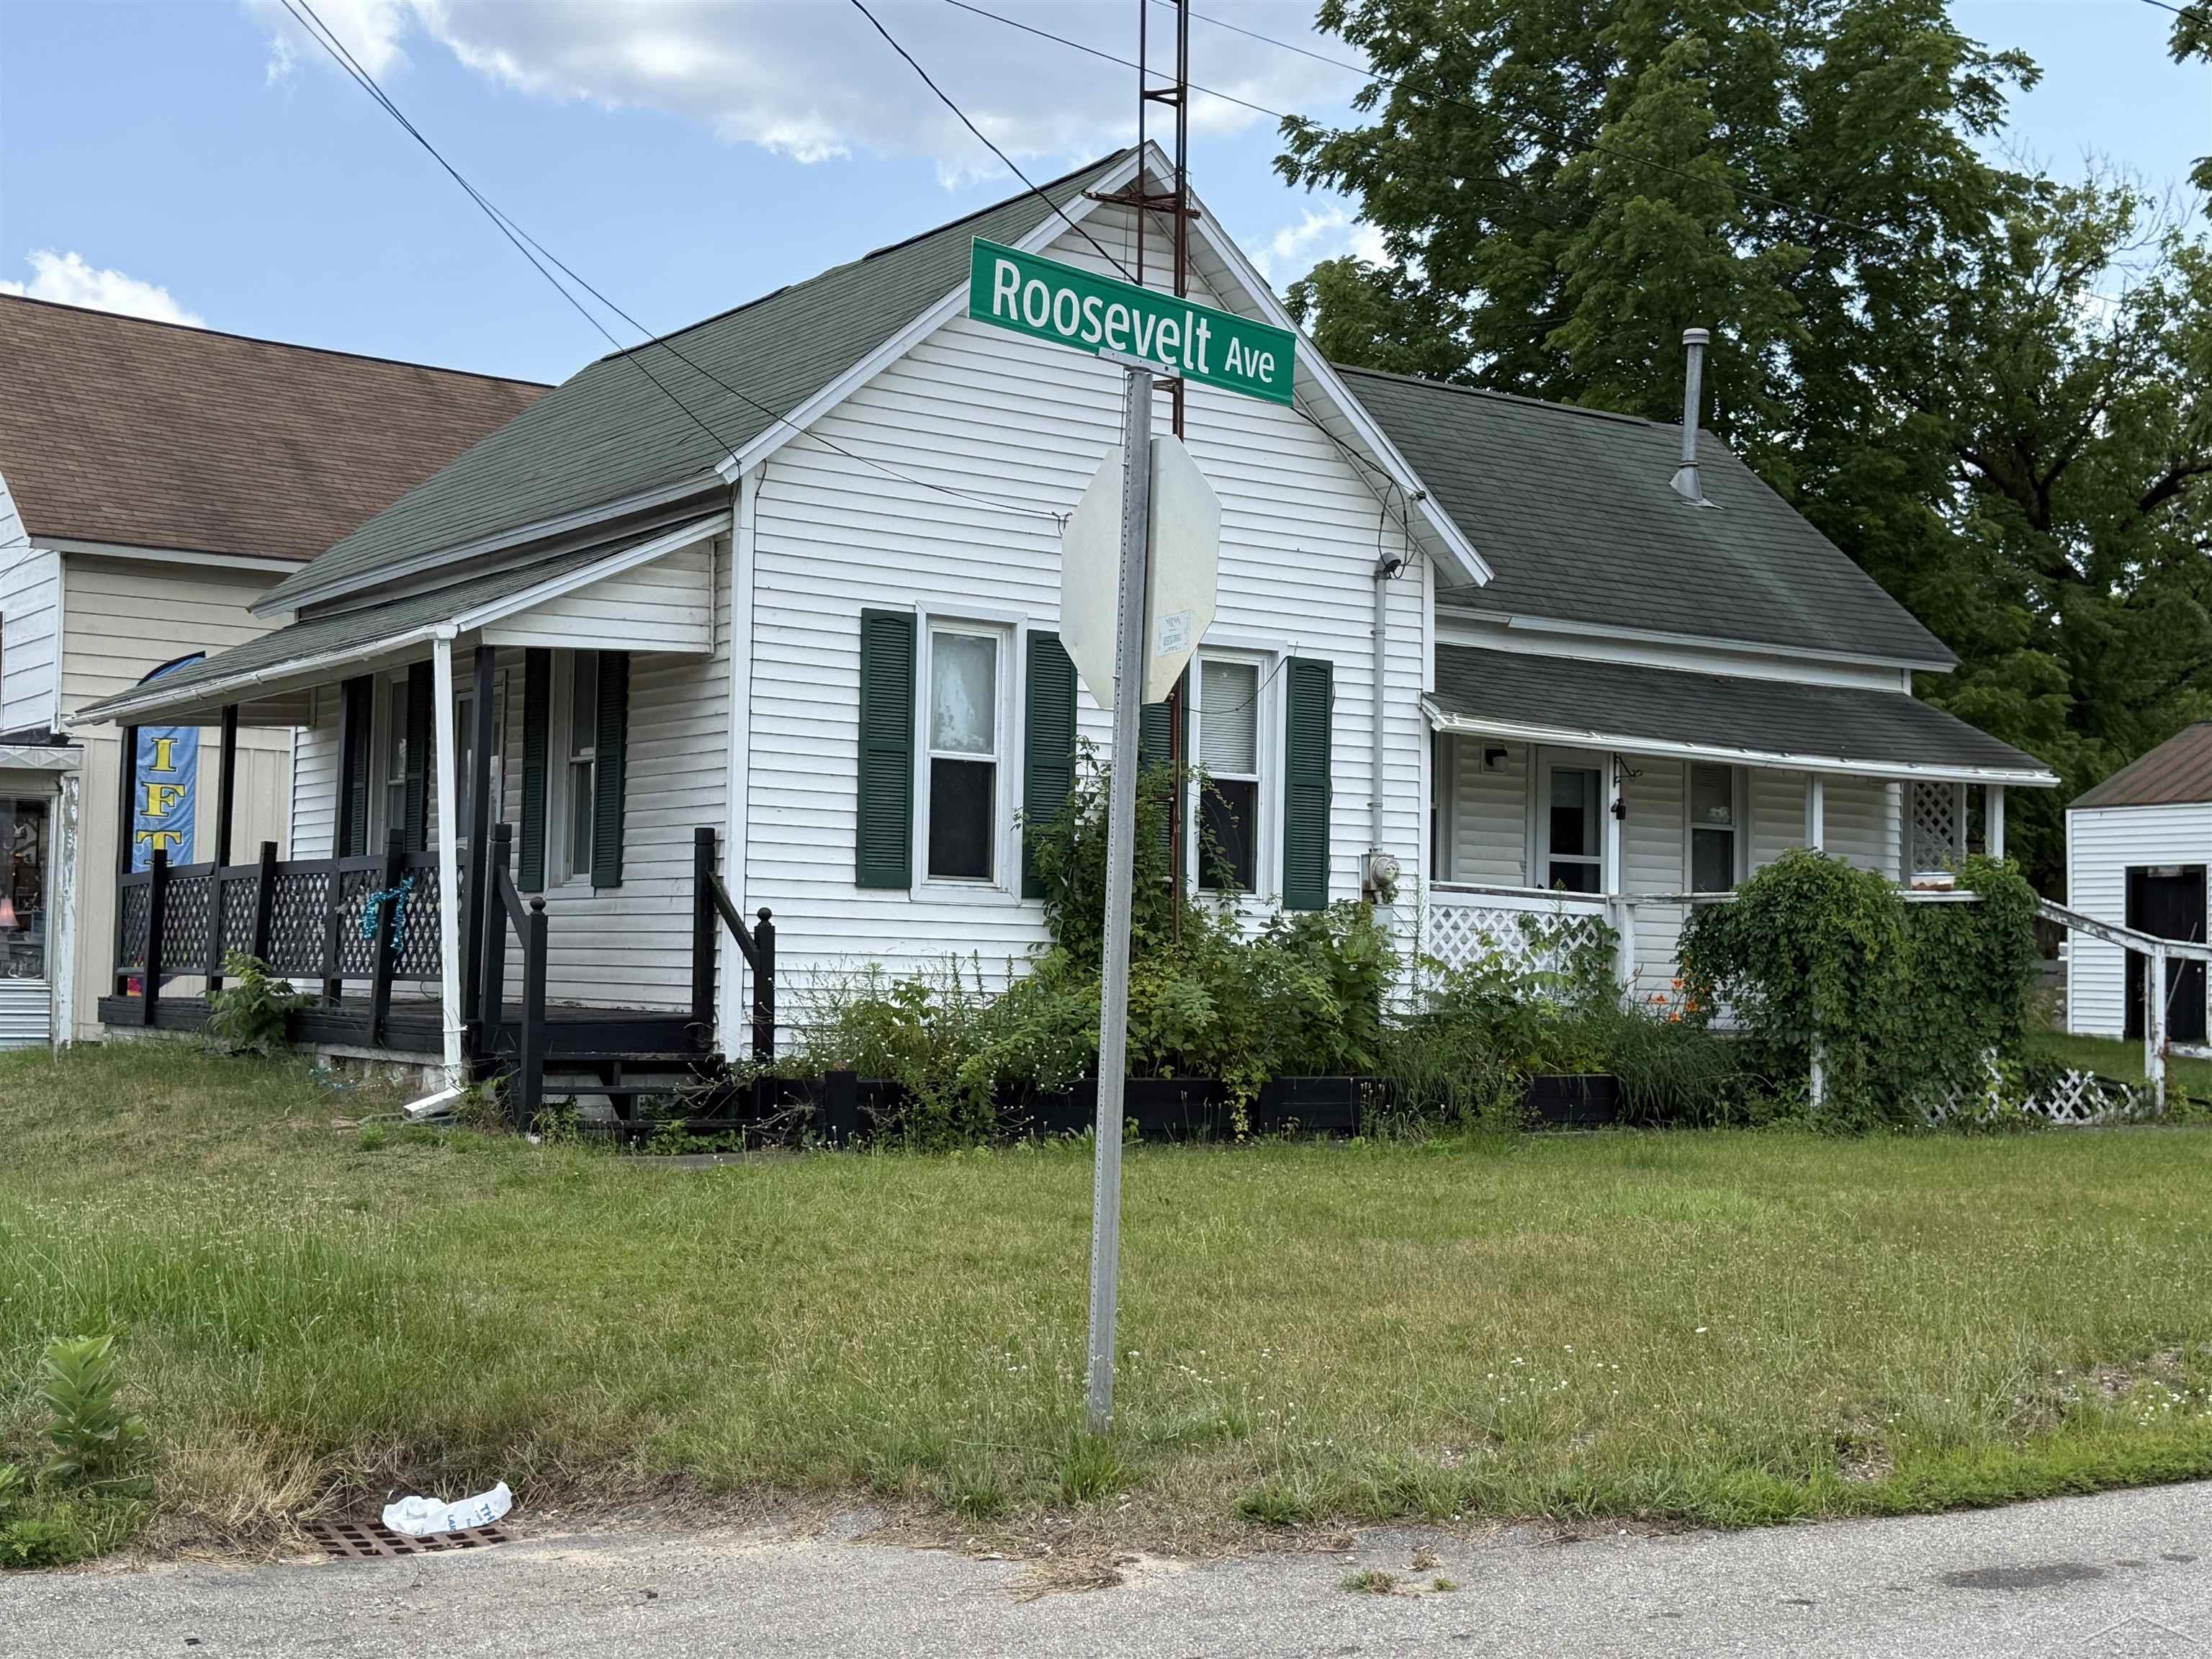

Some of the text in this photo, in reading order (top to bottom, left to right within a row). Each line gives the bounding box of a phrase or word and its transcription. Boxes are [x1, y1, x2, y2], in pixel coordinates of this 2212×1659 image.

[993, 258, 1275, 383] Roosevelt Ave
[135, 737, 186, 866] IFT
